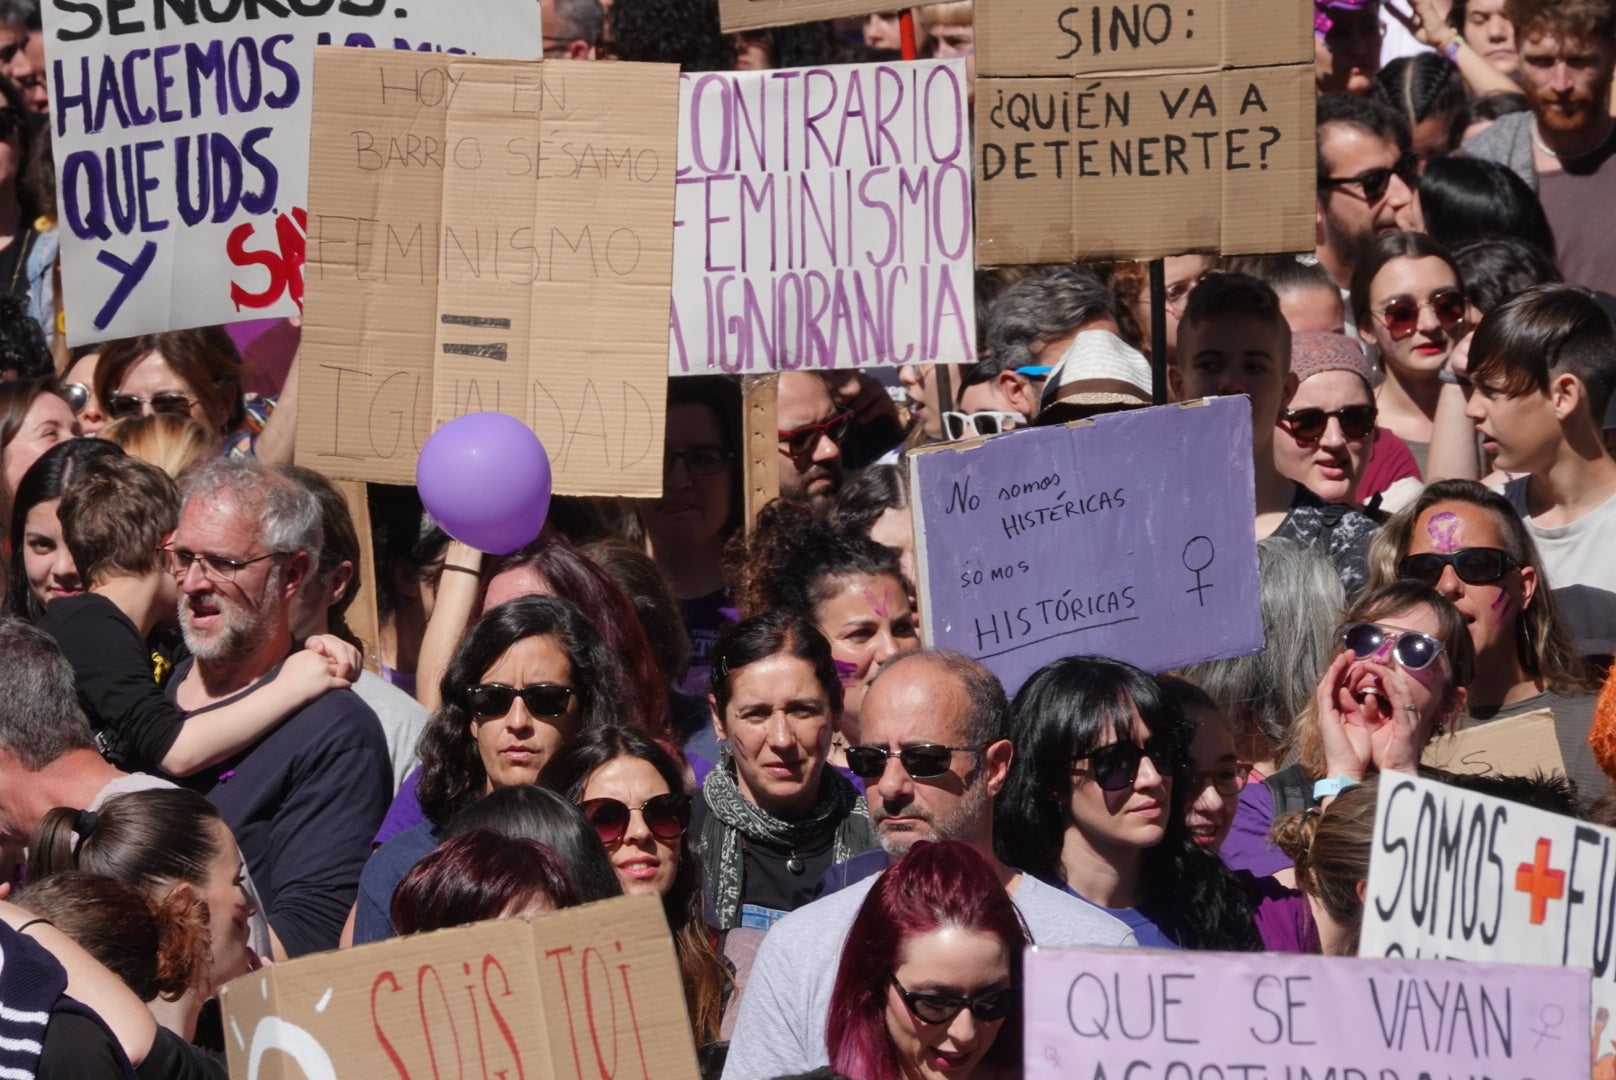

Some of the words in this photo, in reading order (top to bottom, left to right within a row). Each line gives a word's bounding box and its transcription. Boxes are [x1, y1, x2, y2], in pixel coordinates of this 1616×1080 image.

[53, 34, 300, 137] HACEMOS
[380, 67, 465, 109] HOY
[512, 75, 566, 113] EN
[1160, 84, 1217, 119] VA
[1240, 83, 1267, 115] A
[350, 131, 482, 170] BARRIO
[506, 129, 660, 182] SÉSAMO
[982, 126, 1281, 181] DETENERTE?
[62, 140, 170, 241] QUE
[317, 214, 641, 285] FEMINISMO
[94, 240, 157, 330] Y
[704, 263, 973, 373] IGNORANCIA
[945, 475, 981, 515] No
[998, 472, 1061, 501] somos
[1001, 488, 1126, 540] HISTÉRICAS
[975, 586, 1136, 651] HISTÓRICAS
[1374, 781, 1508, 947] SOMOS
[1066, 972, 1200, 1045] QUE
[1250, 974, 1316, 1047] SE
[1368, 977, 1512, 1058] VAYAN
